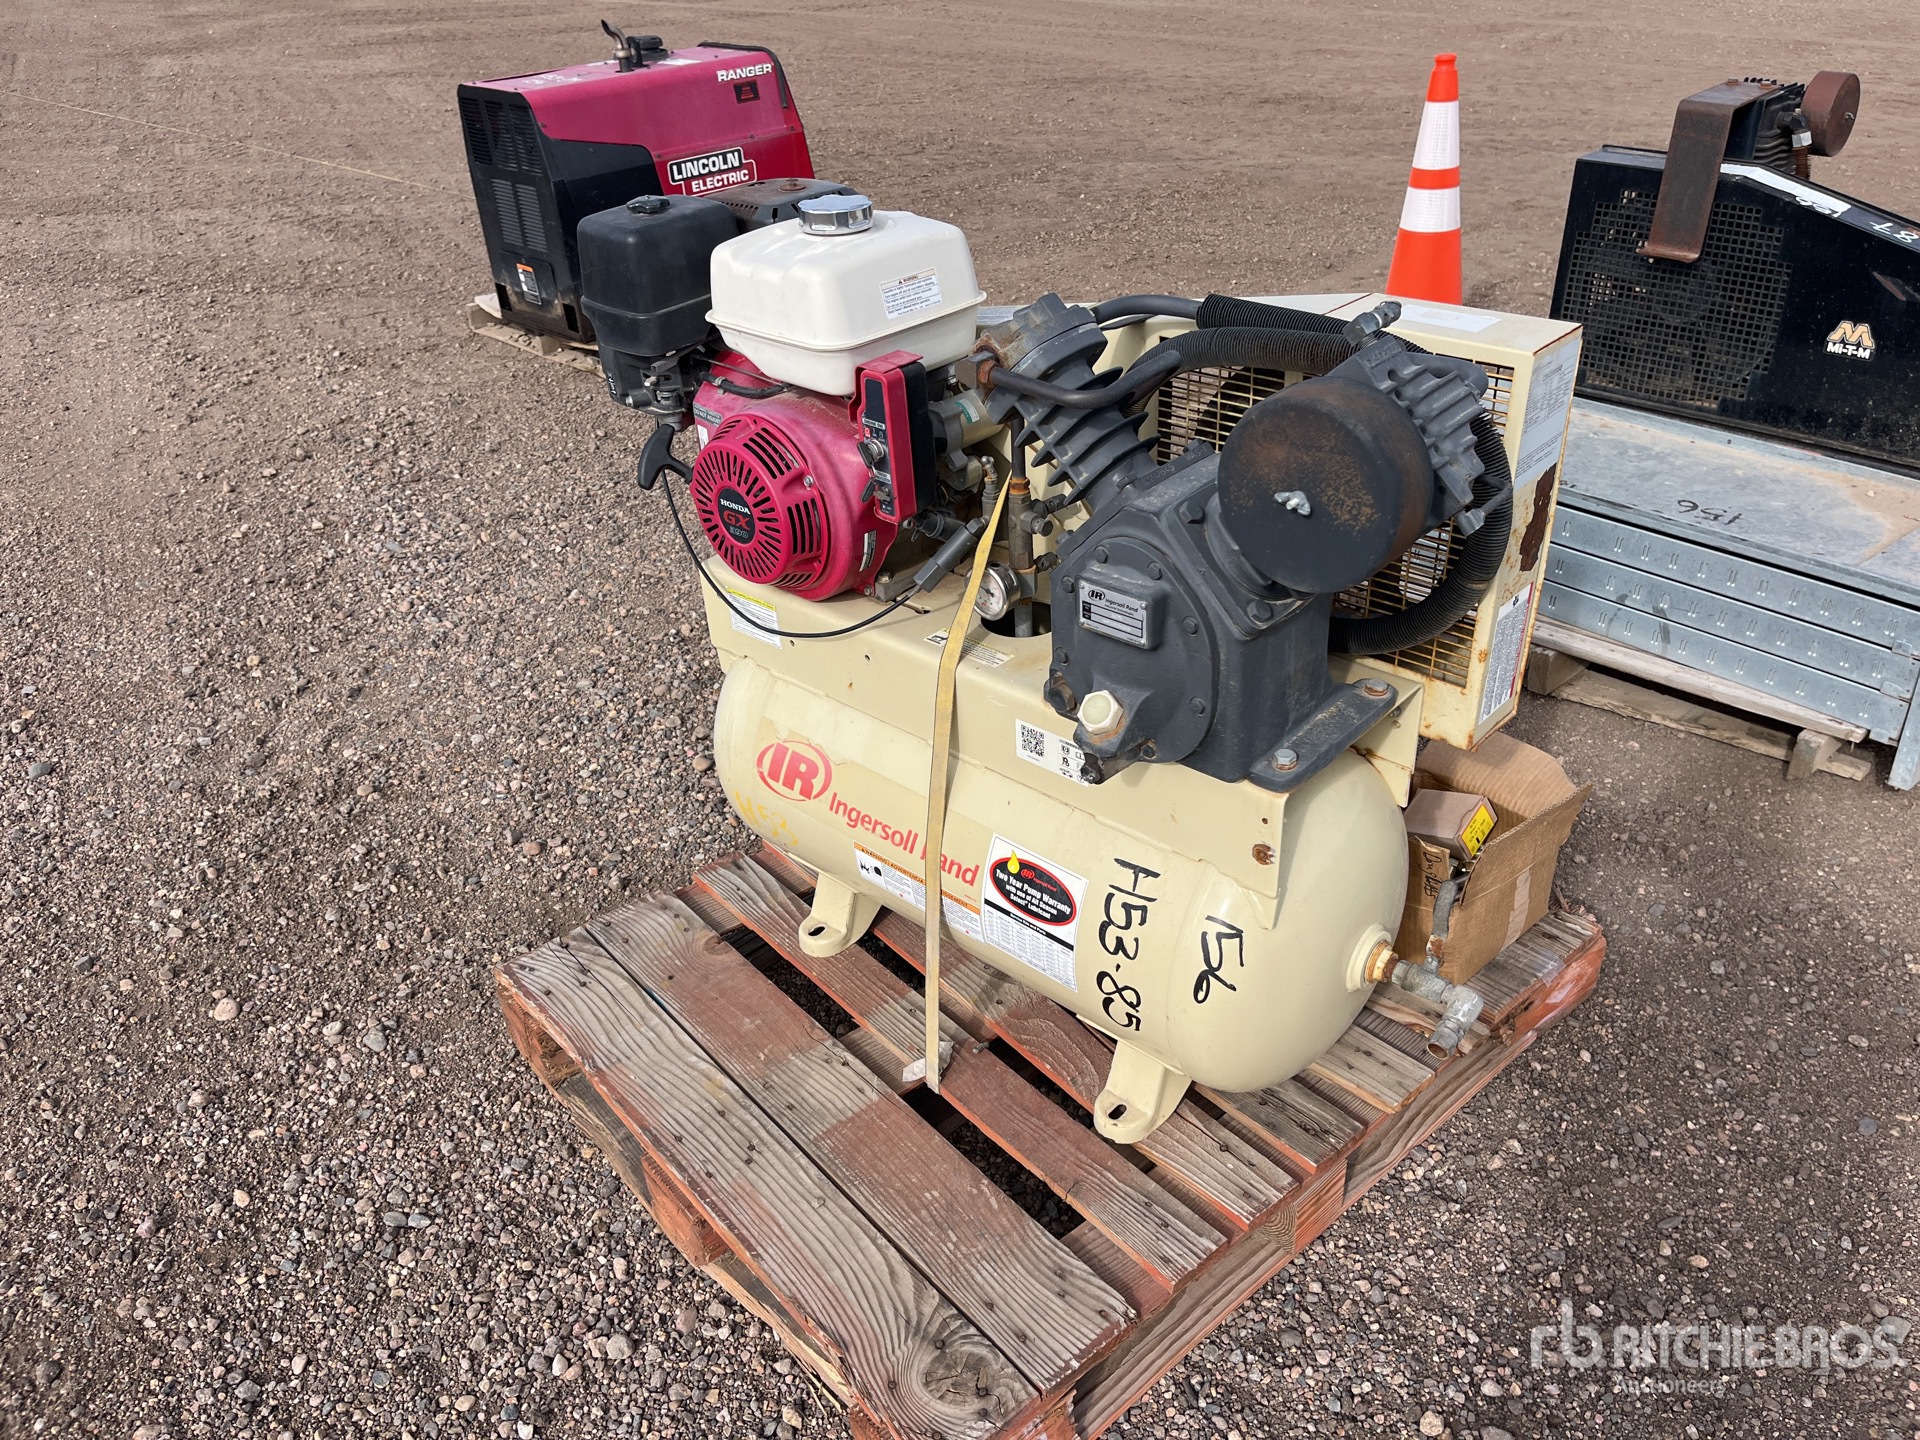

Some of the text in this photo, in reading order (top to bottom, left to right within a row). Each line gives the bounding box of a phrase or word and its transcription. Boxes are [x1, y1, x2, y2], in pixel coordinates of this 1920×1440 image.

[717, 63, 772, 82] RANGER
[672, 152, 740, 180] LINCOLN
[691, 170, 749, 192] ELECTRIC
[1826, 342, 1870, 359] Mi-T-M
[720, 499, 751, 515] HONDA
[724, 511, 750, 530] GX
[730, 526, 748, 538] 390
[1090, 590, 1104, 600] IR
[1126, 604, 1138, 612] Rand
[765, 742, 821, 800] IR
[829, 792, 919, 854] Ingersoll
[920, 842, 980, 887] and
[996, 869, 1071, 915] Two Year Pump Warranty
[1006, 884, 1016, 893] with
[1017, 890, 1026, 898] use
[1039, 901, 1057, 915] Season
[1028, 903, 1051, 919] Lubricant
[1193, 915, 1244, 1004] 156
